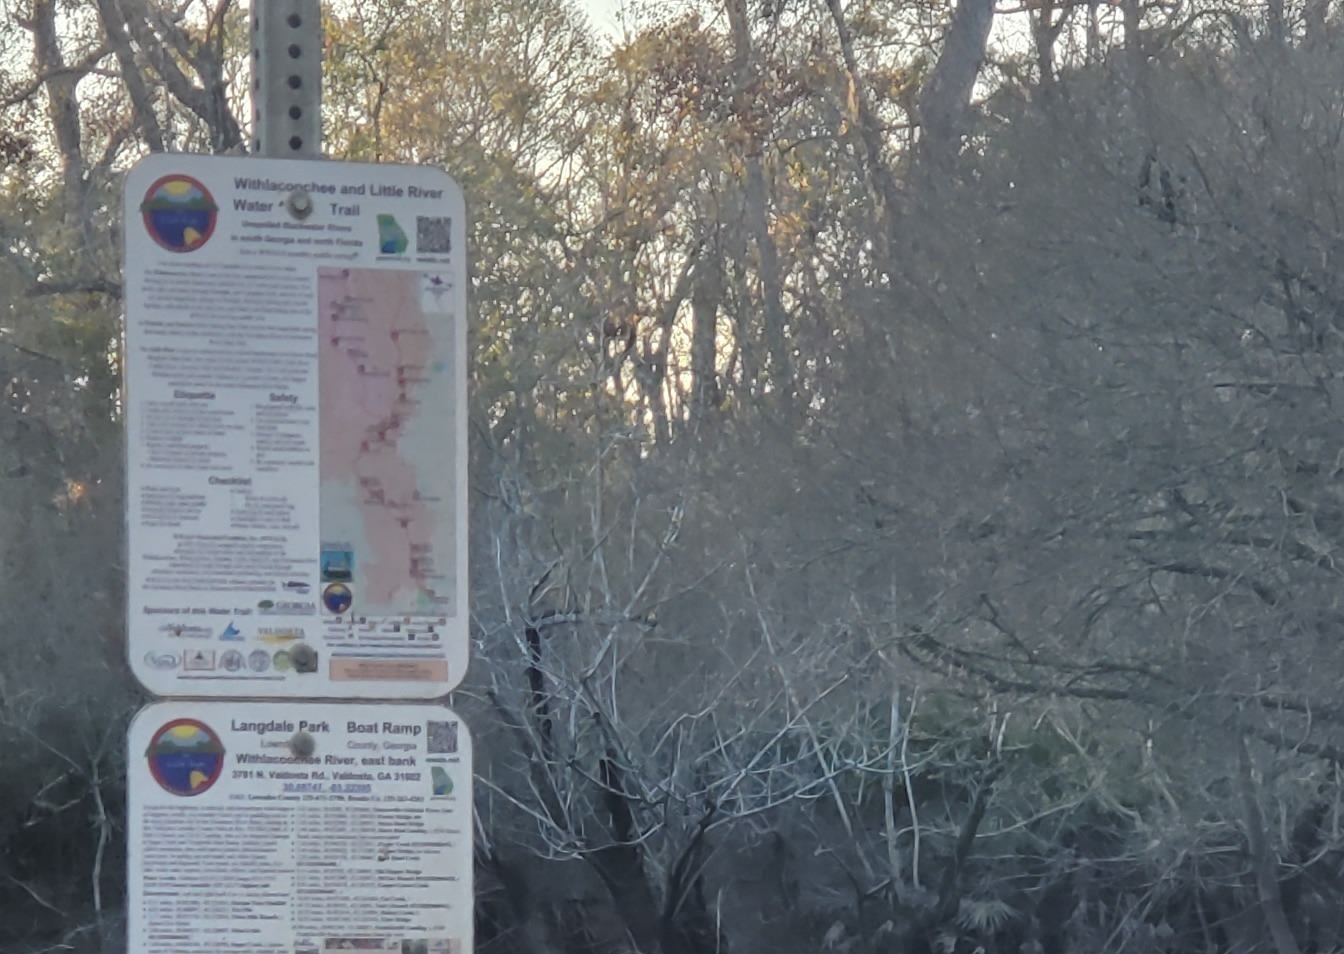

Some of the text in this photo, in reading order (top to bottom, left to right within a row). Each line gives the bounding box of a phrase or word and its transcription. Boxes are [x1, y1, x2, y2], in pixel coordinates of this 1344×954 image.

[340, 183, 365, 195] and
[369, 184, 403, 197] Little
[408, 186, 444, 198] River
[232, 199, 360, 216] Water Trail
[269, 393, 299, 404] Safety
[208, 475, 252, 486] Checklist
[231, 719, 422, 736] Langdale Park Boat Ramp
[361, 755, 385, 765] east
[388, 755, 417, 766] bank
[377, 772, 392, 781] GA
